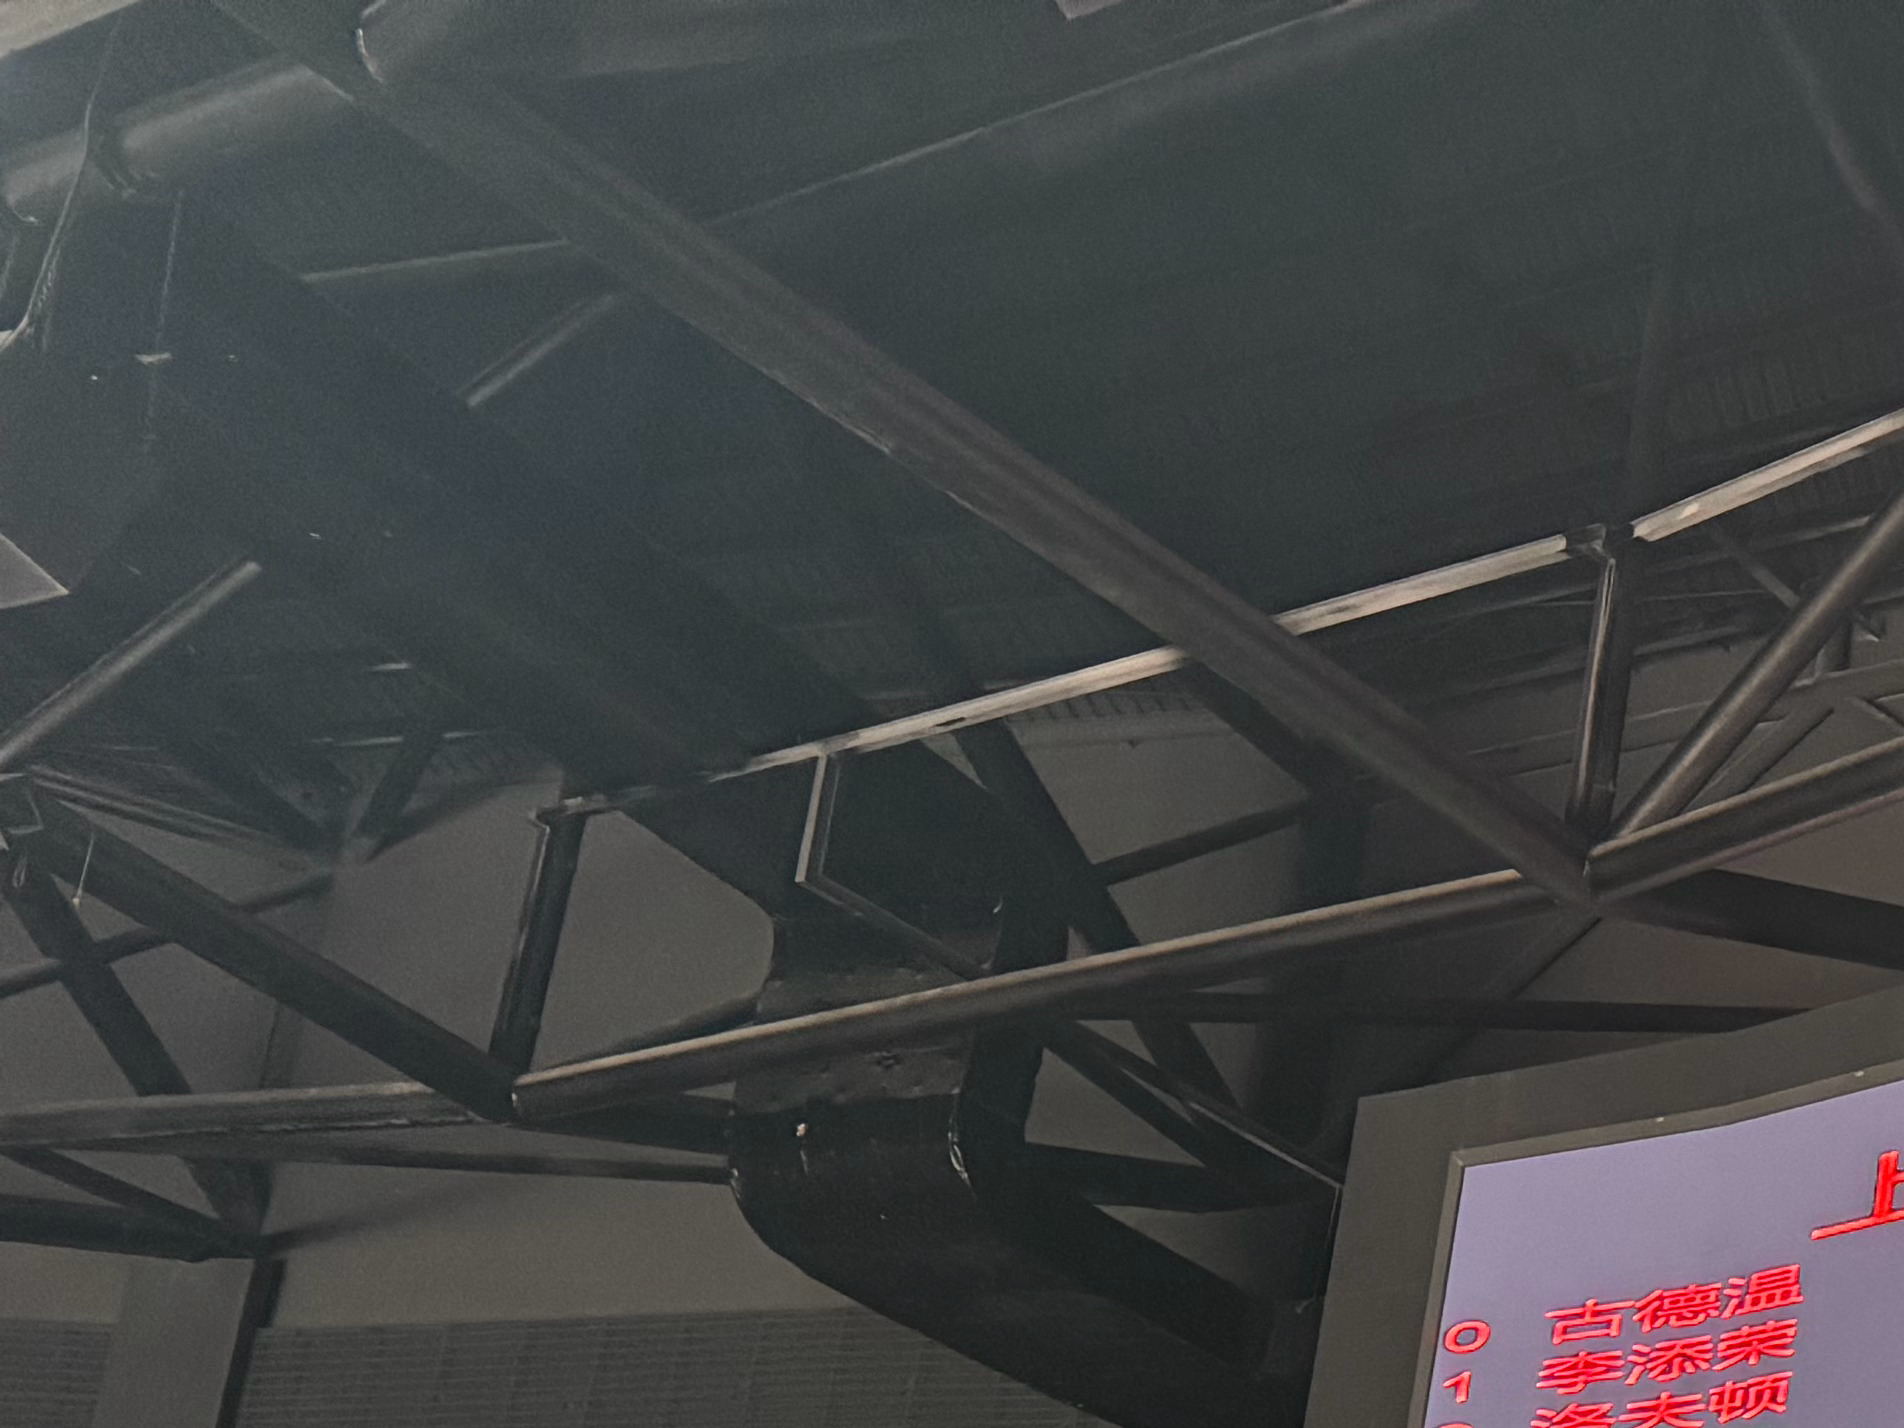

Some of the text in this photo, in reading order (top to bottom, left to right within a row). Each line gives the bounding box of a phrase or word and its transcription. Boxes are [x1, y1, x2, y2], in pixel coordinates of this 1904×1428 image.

[1444, 1320, 1492, 1354] 0
[1544, 1264, 1805, 1346] 古德温
[1444, 1372, 1472, 1404] 1
[1536, 1320, 1798, 1396] 李添荣
